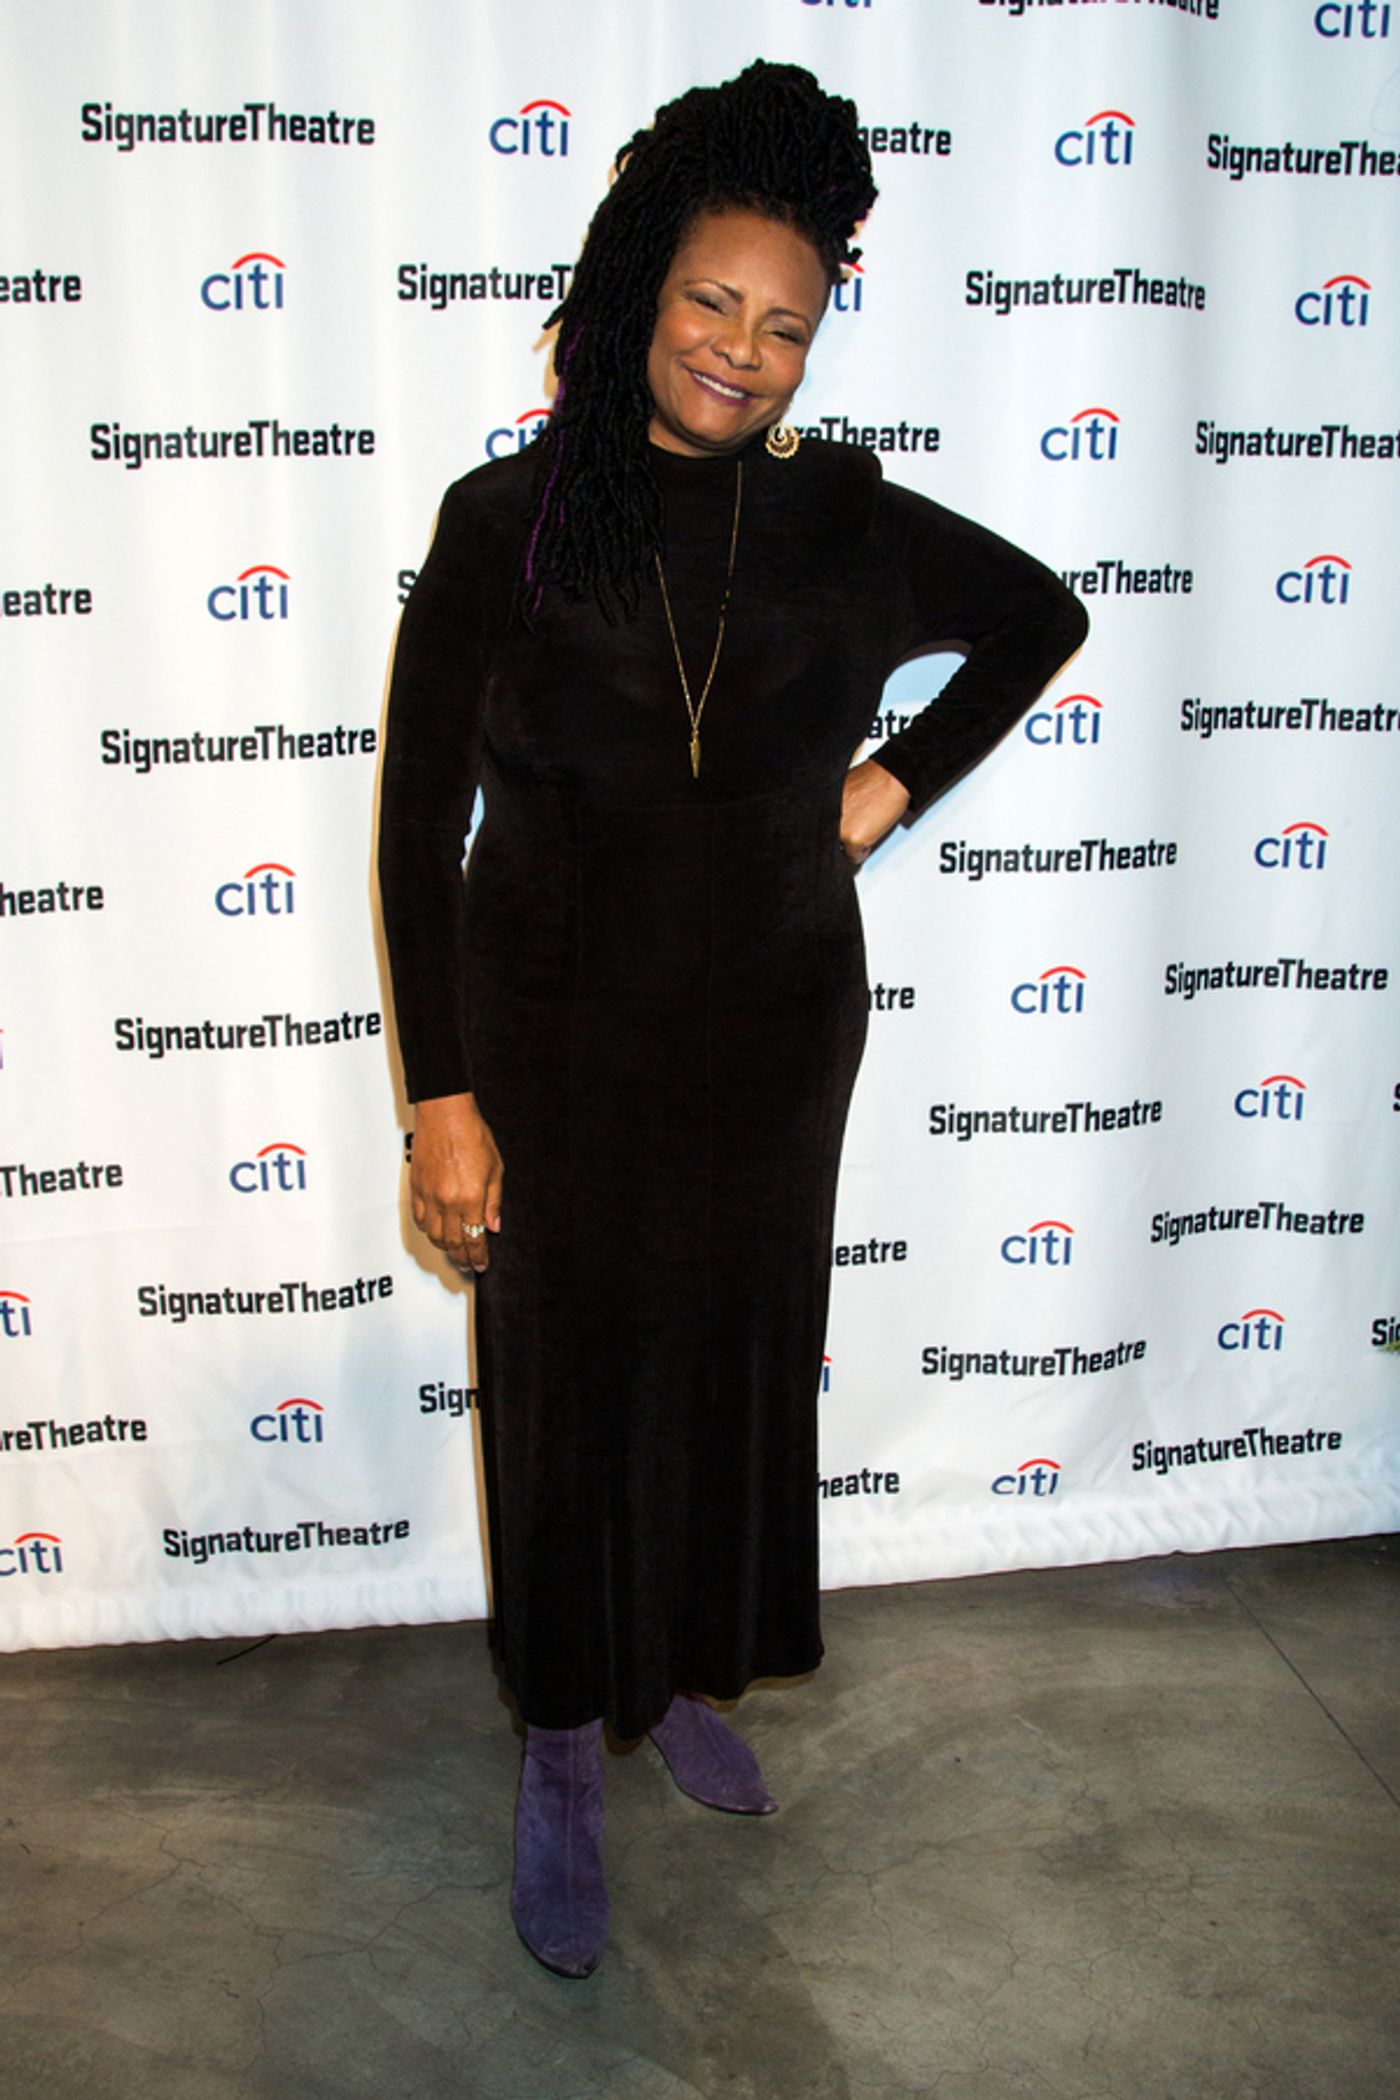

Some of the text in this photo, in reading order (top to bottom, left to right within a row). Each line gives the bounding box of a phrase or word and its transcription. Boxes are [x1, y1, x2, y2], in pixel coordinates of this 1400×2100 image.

[1314, 0, 1391, 39] citi
[82, 103, 375, 152] SignatureTheatre
[490, 99, 571, 156] citi
[1055, 110, 1135, 165] citi
[1207, 133, 1400, 181] SignatureThe
[201, 252, 285, 310] citi
[966, 268, 1206, 316] SignatureTheatre
[1295, 275, 1371, 326] citi
[91, 420, 375, 469] SignatureTheatre
[1041, 407, 1119, 461] citi
[208, 564, 289, 620] citi
[1276, 555, 1351, 604] citi
[1025, 694, 1102, 745] citi
[1181, 697, 1400, 739] SignatureTheatr
[101, 725, 377, 774] SignatureTheatre
[939, 838, 1178, 881] SignatureTheatre
[1254, 822, 1328, 870] citi
[215, 863, 295, 916] citi
[1011, 966, 1086, 1014] citi
[1165, 958, 1389, 1001] SignatureTheatre
[114, 1011, 381, 1059] SignatureTheatre
[930, 1099, 1163, 1142] SignatureTheatre
[1234, 1075, 1305, 1121] citi
[230, 1142, 305, 1193] citi
[1001, 1220, 1073, 1265] citi
[1151, 1201, 1365, 1247] SignatureTheatre
[833, 1238, 907, 1267] eatre
[139, 1275, 393, 1323] SignatureTheatre
[1217, 1309, 1284, 1351] citi
[922, 1340, 1147, 1381] SignatureTheatre
[0, 1414, 148, 1451] reTheatre
[250, 1398, 323, 1443] citi
[1132, 1427, 1343, 1476] SignatureTheatre
[991, 1458, 1061, 1497] citi
[0, 1532, 62, 1577] citi
[163, 1519, 410, 1565] SignatureTheatre
